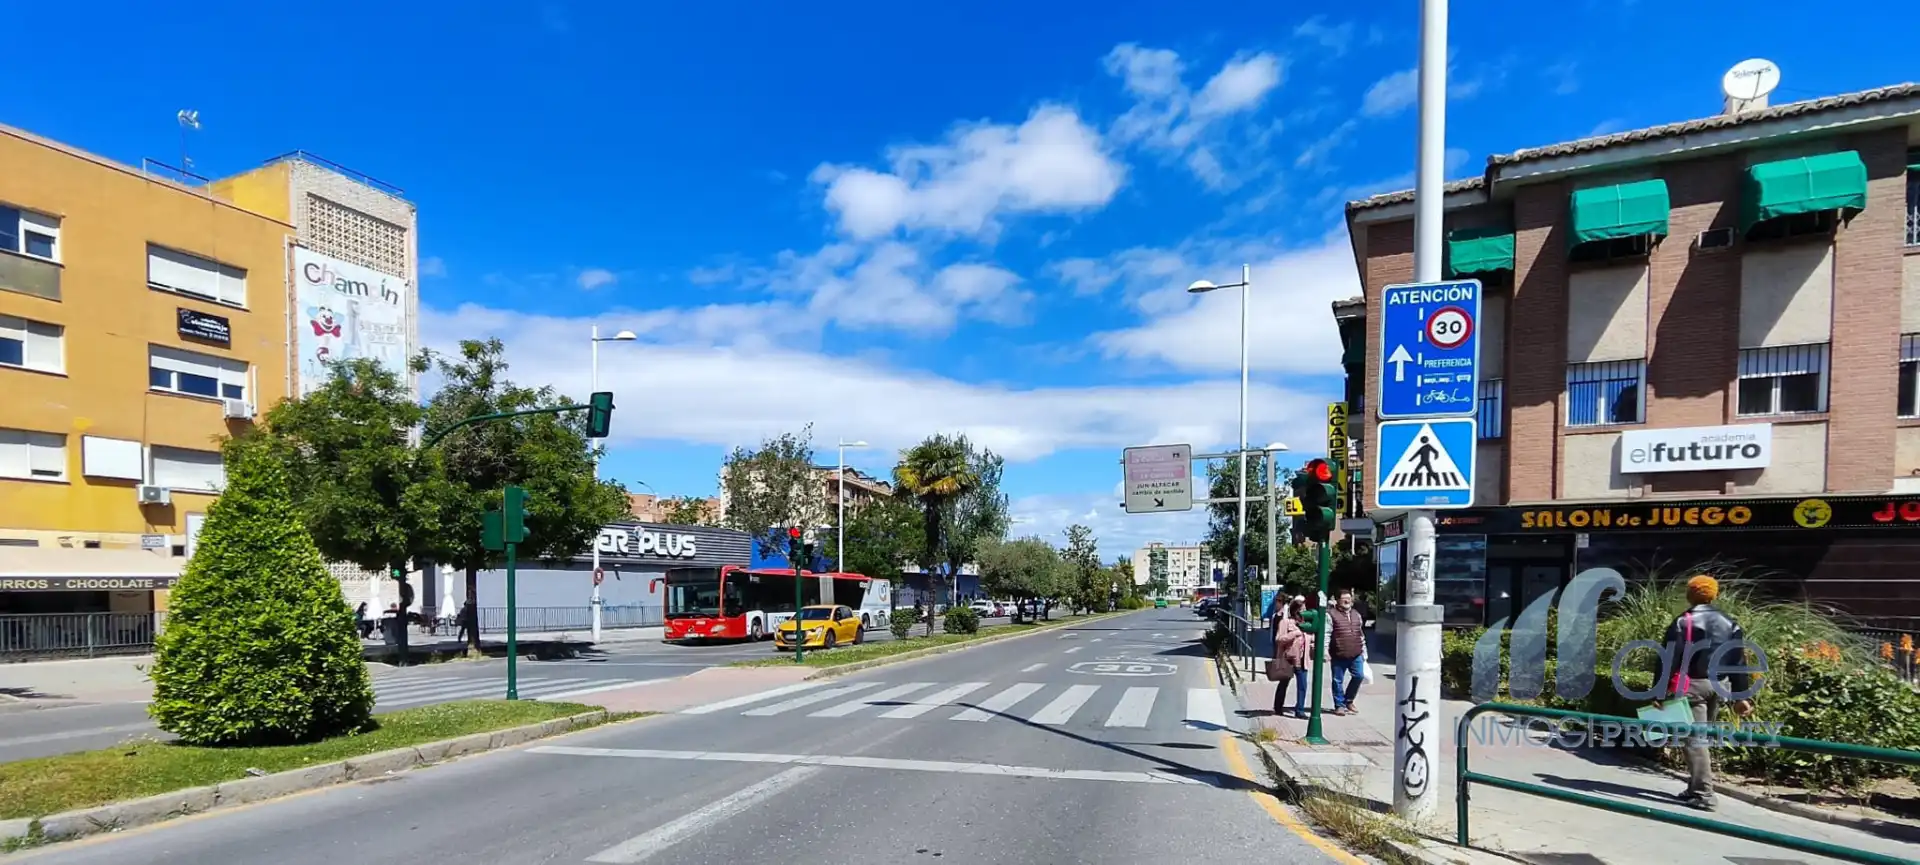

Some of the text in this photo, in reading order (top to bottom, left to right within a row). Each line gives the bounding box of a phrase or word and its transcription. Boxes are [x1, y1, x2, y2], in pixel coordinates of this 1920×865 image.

[1389, 285, 1473, 305] ATENCIÓN
[1436, 320, 1462, 335] 30
[1424, 358, 1472, 368] PREFERENCIA
[1701, 432, 1756, 443] academia
[1286, 501, 1297, 512] EL
[1519, 506, 1753, 528] SALON de JUEGO
[638, 531, 697, 556] PLUS
[66, 579, 153, 589] CHOCOLATE
